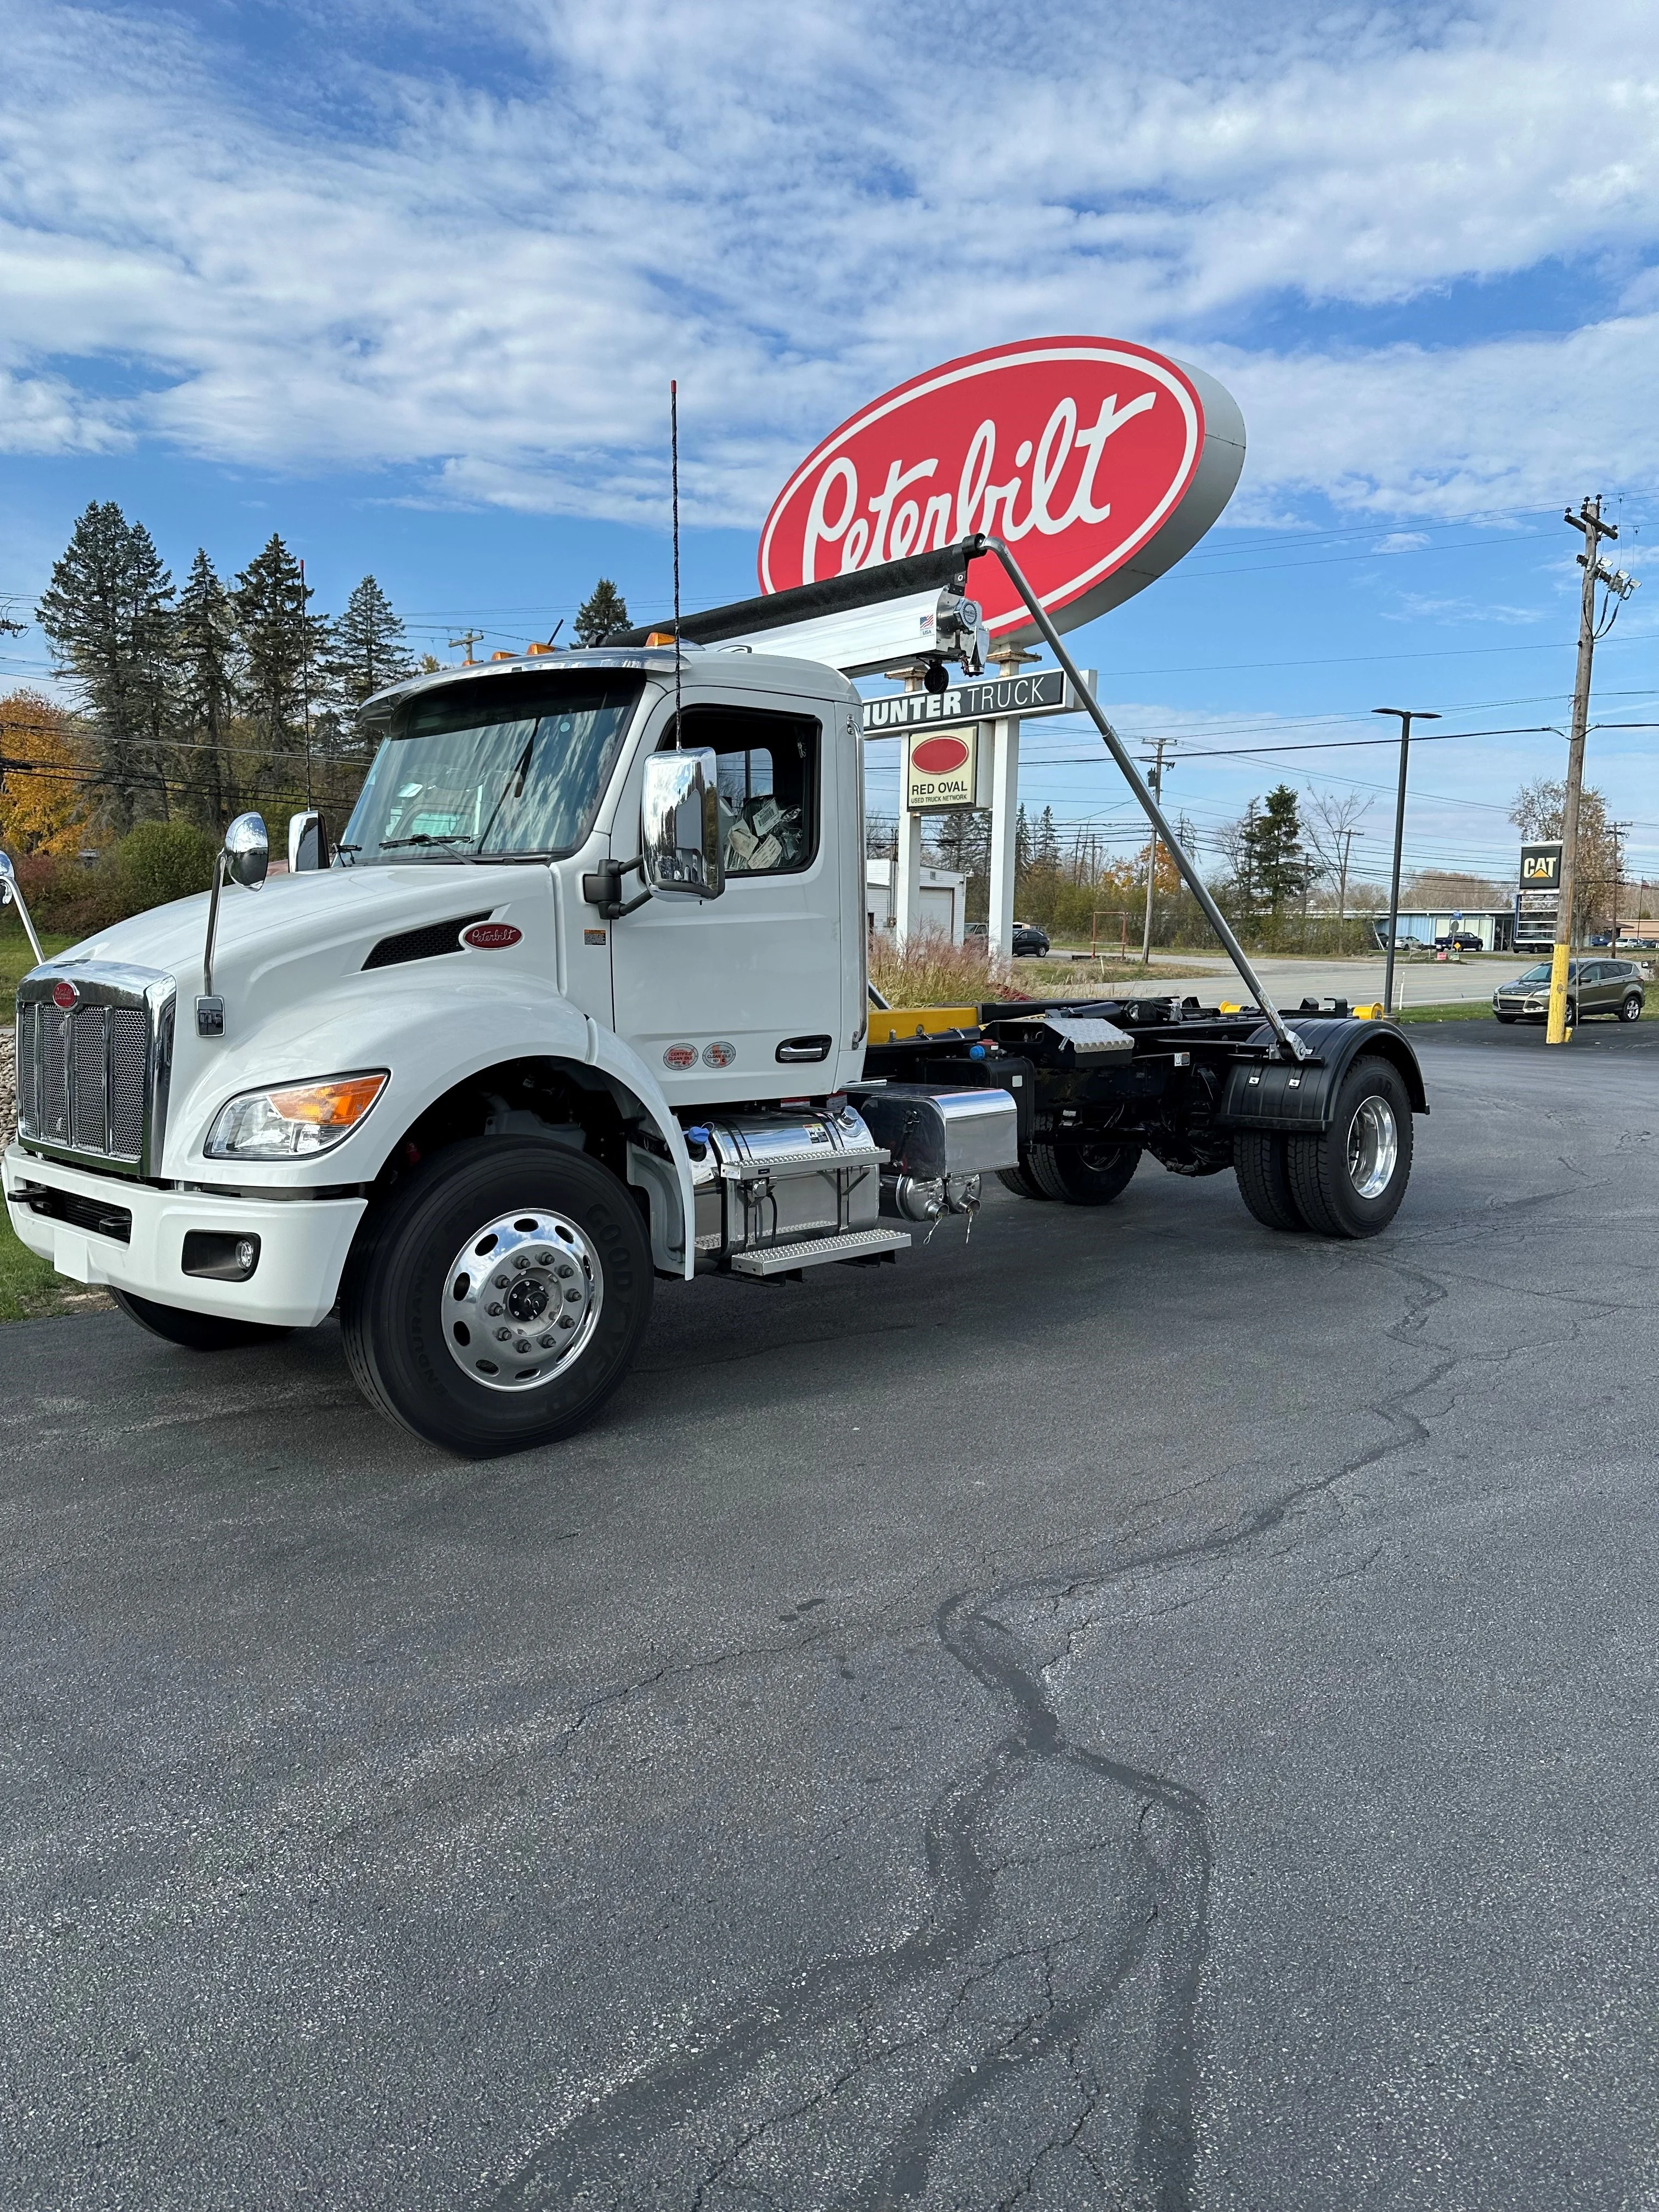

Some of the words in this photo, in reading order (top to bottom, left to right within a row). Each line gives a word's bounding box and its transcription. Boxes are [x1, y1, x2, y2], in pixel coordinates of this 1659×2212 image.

[802, 391, 1157, 584] Peterbilt
[967, 676, 1045, 712] TRUCK
[912, 783, 935, 795] RED
[938, 780, 968, 793] OVAL
[1523, 857, 1558, 878] CAT
[472, 929, 517, 944] Peterbilt
